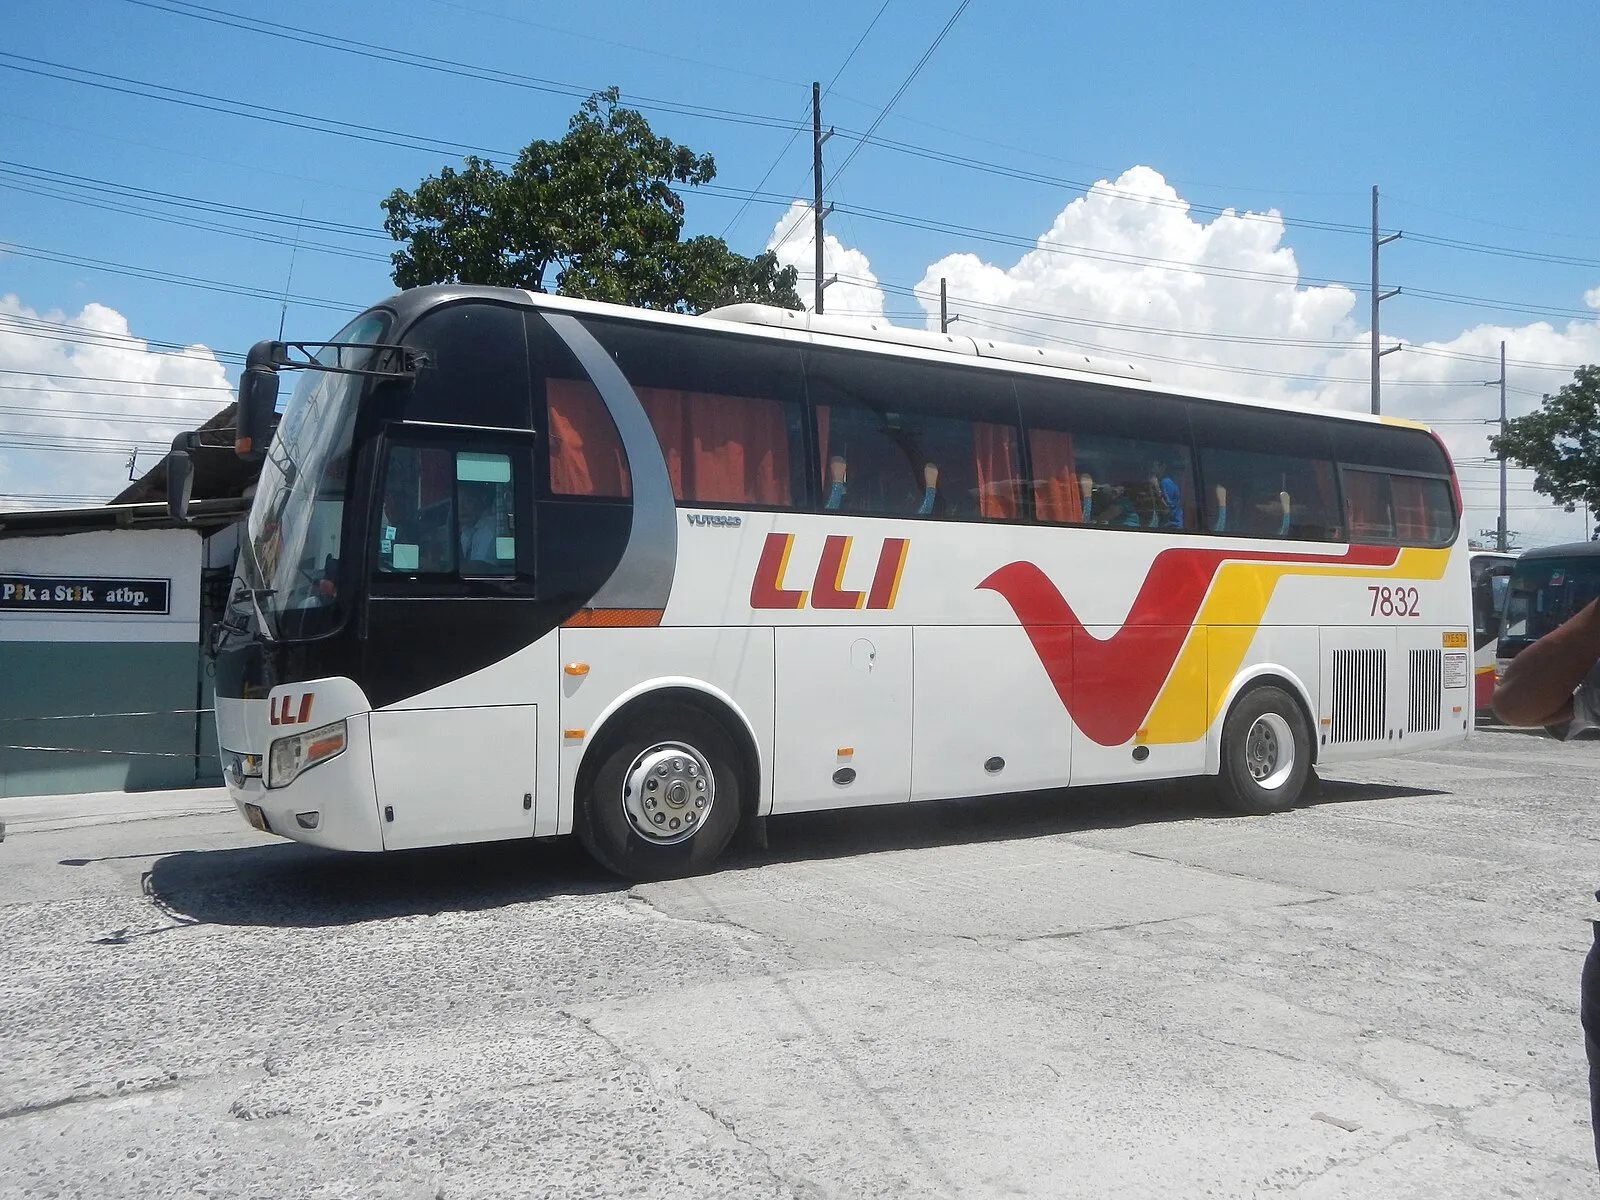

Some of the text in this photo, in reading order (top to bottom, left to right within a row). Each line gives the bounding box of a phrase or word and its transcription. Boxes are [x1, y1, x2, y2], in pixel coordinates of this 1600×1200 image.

[750, 532, 910, 610] LLI
[41, 588, 51, 601] a
[106, 587, 149, 606] atbp.
[1367, 586, 1420, 617] 7832
[270, 692, 314, 725] LLI
